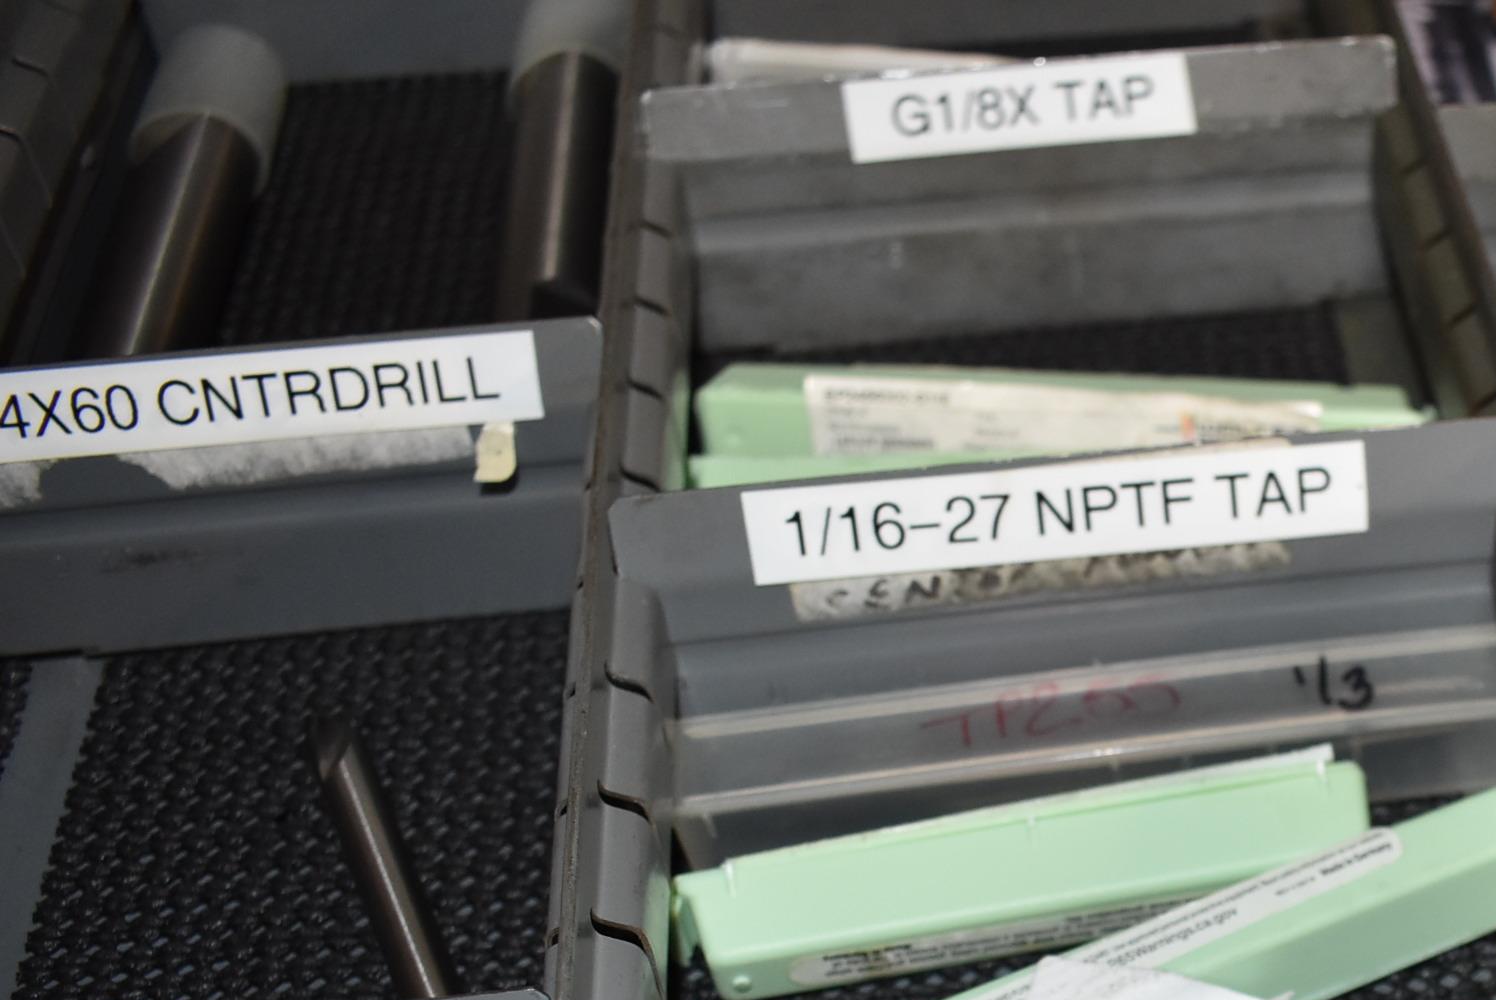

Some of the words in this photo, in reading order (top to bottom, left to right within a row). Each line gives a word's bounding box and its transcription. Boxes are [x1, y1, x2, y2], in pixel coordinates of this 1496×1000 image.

[891, 85, 1040, 137] G1/8X
[1052, 74, 1156, 121] TAP
[0, 385, 139, 440] 4X60
[157, 356, 501, 426] CNTRDRILL
[1036, 479, 1193, 535] NPTF
[1215, 467, 1332, 518] TAP
